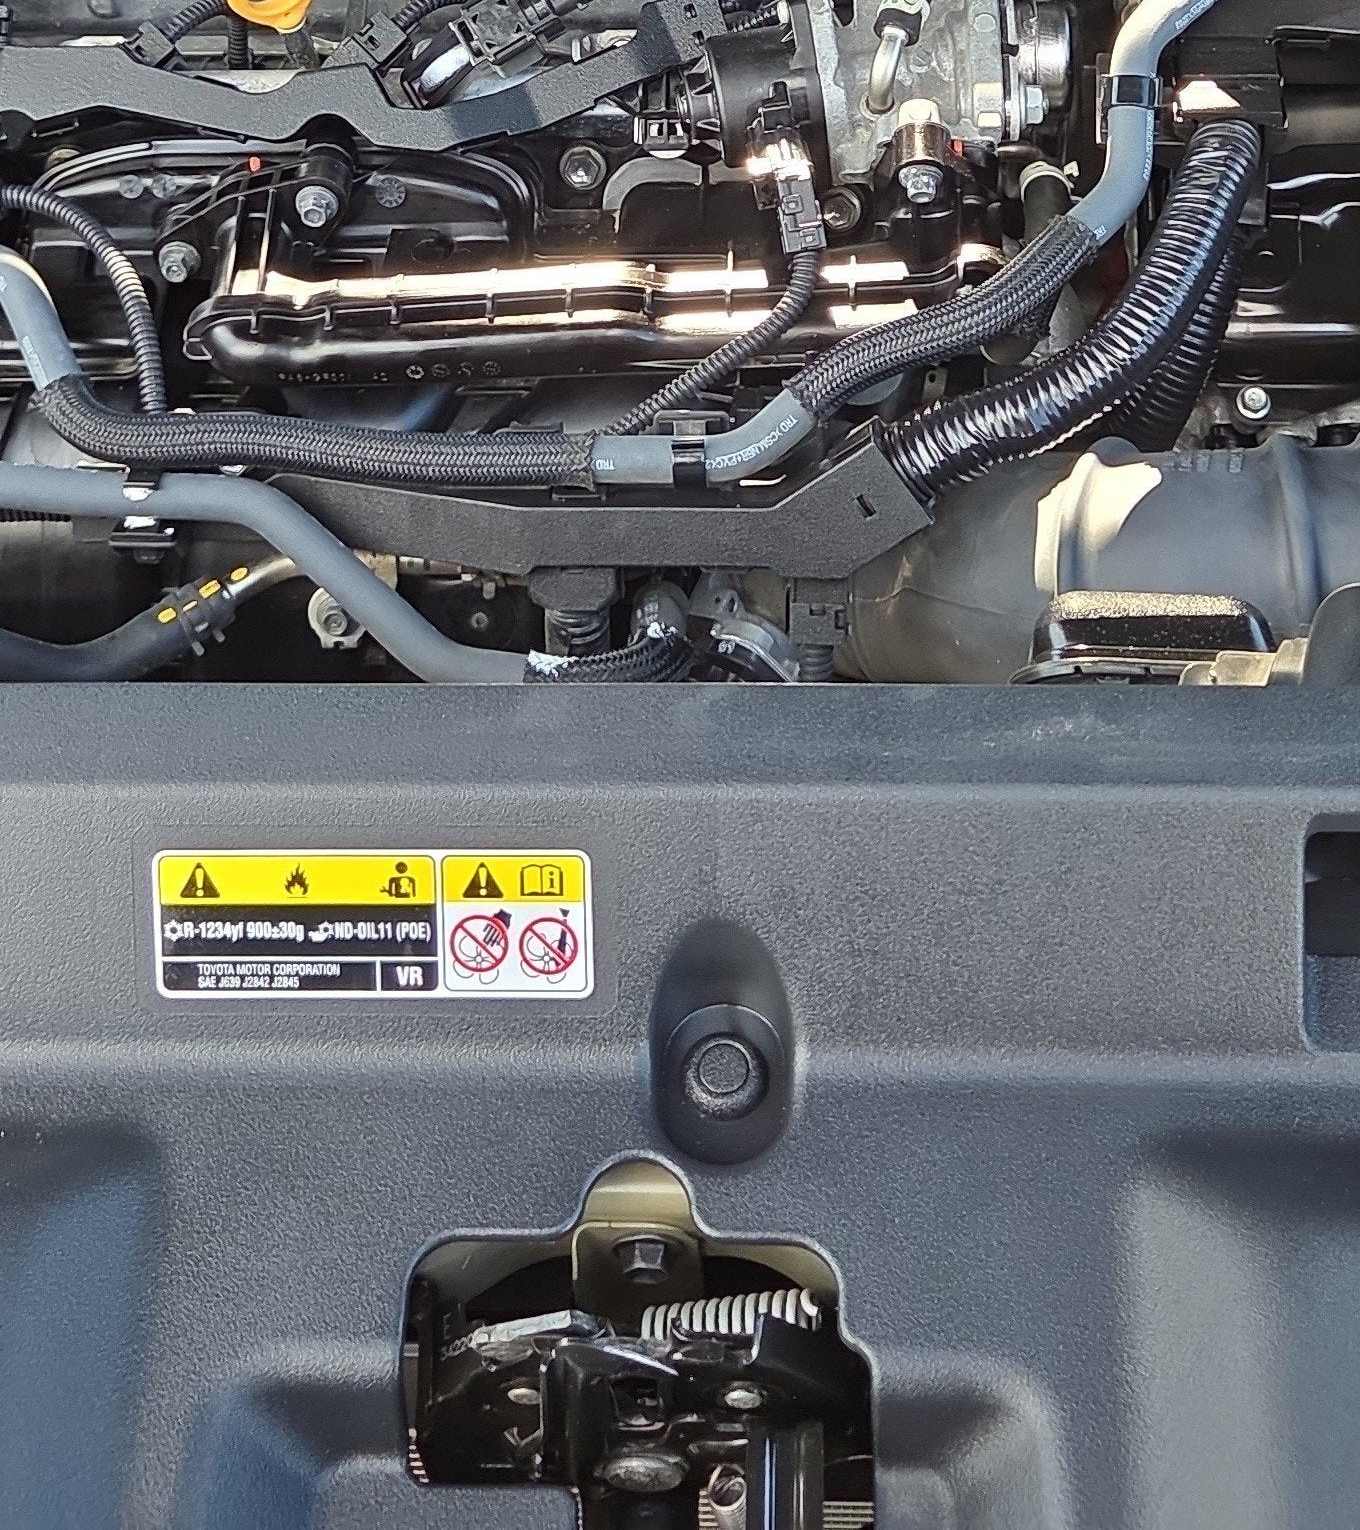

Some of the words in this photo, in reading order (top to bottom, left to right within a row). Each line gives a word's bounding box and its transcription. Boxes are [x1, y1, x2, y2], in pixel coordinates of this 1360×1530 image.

[183, 922, 243, 943] R-1234yf
[246, 922, 305, 943] 900±30g
[334, 922, 393, 939] ND-OIL11
[396, 922, 432, 943] (POE)
[198, 964, 236, 975] TOYOTA
[237, 964, 271, 975] MOTOR
[272, 964, 341, 976] CORPORATION
[396, 966, 424, 986] VR
[198, 977, 217, 988] SAE
[218, 977, 241, 988] J639
[242, 977, 270, 988] J2842
[272, 977, 300, 988] J2845
